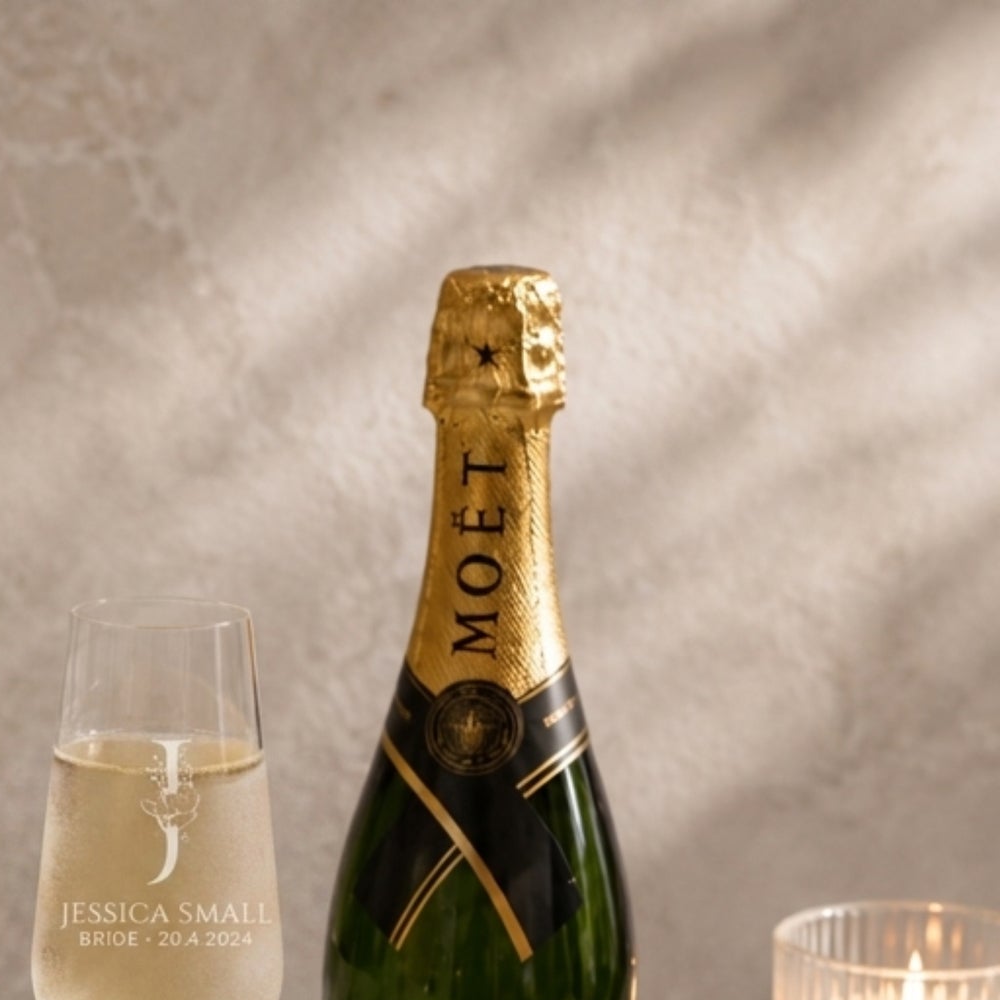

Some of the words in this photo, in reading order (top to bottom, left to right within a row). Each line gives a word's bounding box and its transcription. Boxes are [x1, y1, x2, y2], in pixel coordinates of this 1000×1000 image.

[146, 738, 193, 886] J
[60, 901, 170, 930] JESSICA
[178, 901, 273, 925] SMALL
